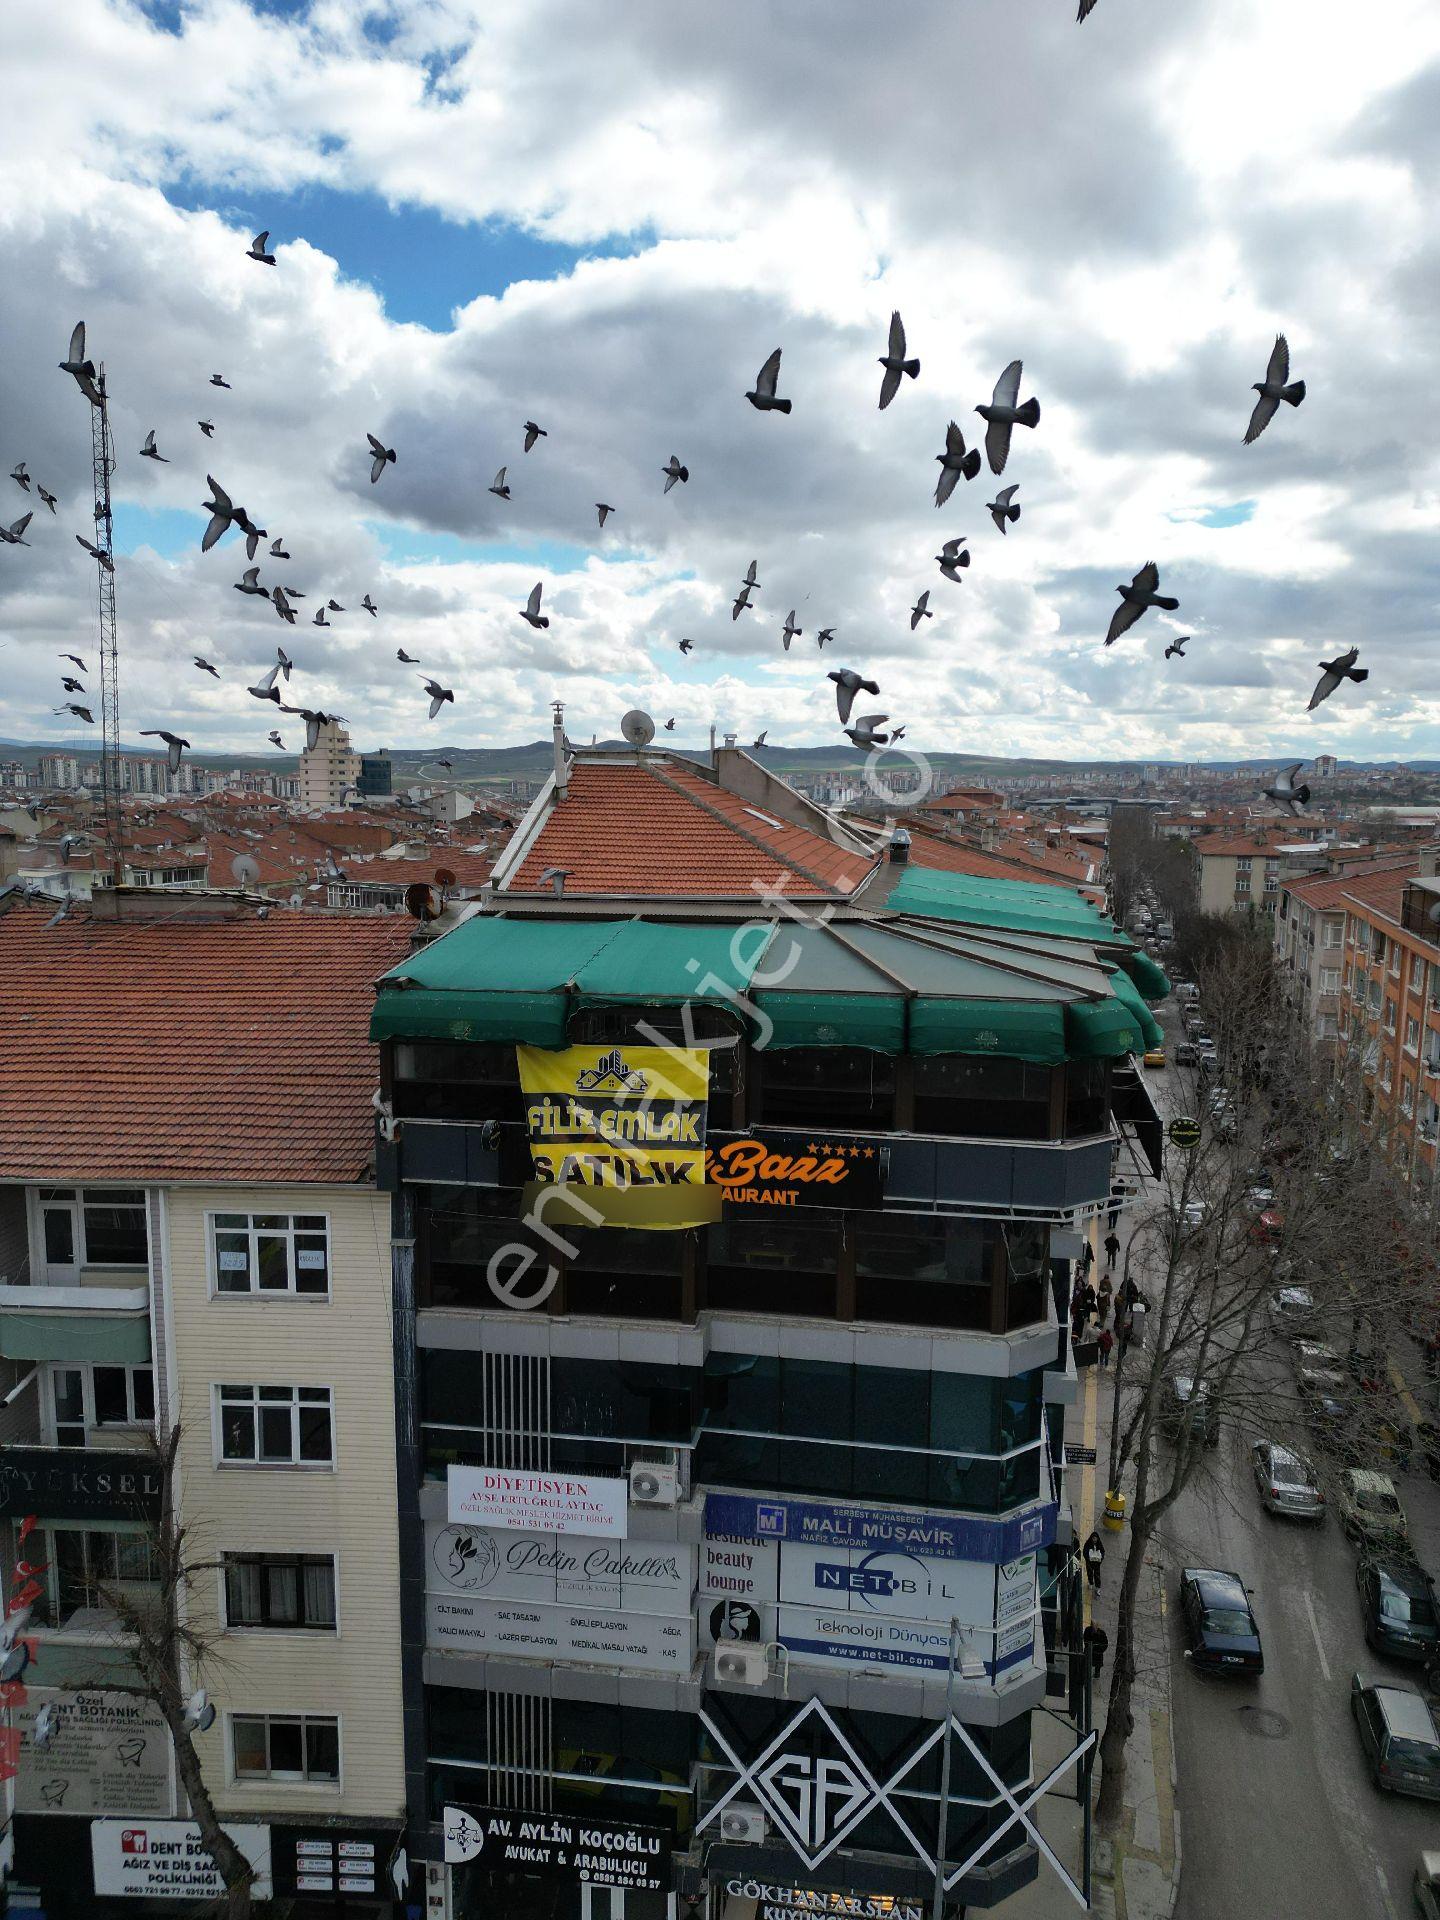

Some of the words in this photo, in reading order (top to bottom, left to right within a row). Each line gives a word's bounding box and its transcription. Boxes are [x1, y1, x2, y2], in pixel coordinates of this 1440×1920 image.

[527, 1097, 597, 1136] FİLİZ
[599, 1107, 702, 1142] EMLAK
[532, 1153, 697, 1185] SATILIK
[720, 1187, 800, 1206] AURANT
[499, 1494, 565, 1509] ERTUĞRUL
[507, 1518, 526, 1527] 0541
[528, 1520, 541, 1528] 531
[544, 1521, 554, 1529] 05
[555, 1522, 565, 1530] 42
[832, 1508, 871, 1520] SERBEST
[862, 1521, 955, 1546] MÜŞAVİR
[506, 1540, 580, 1571] Pelin
[707, 1548, 753, 1571] beauty
[706, 1570, 754, 1593] lounge
[498, 1632, 520, 1643] LAZER
[815, 1618, 883, 1641] Teknoloji
[571, 1639, 601, 1650] MEDİKAL
[601, 1642, 625, 1652] MASAJ
[828, 1646, 934, 1667] www.net-bil.com
[79, 1704, 141, 1718] BOTANİK
[185, 1832, 202, 1841] Öze
[487, 1818, 513, 1838] AV.
[519, 1821, 572, 1844] AYLİN
[579, 1829, 661, 1855] KOÇOĞLU
[150, 1842, 182, 1855] DENT
[122, 1857, 151, 1870] AĞIZ
[153, 1859, 170, 1871] VE
[172, 1858, 192, 1872] DİŞ
[504, 1844, 551, 1863] AVUKAT
[557, 1850, 567, 1865] &
[573, 1852, 648, 1876] ARABULUCU
[726, 1879, 829, 1910] GÖKHAN
[834, 1895, 924, 1920] ARSLAN
